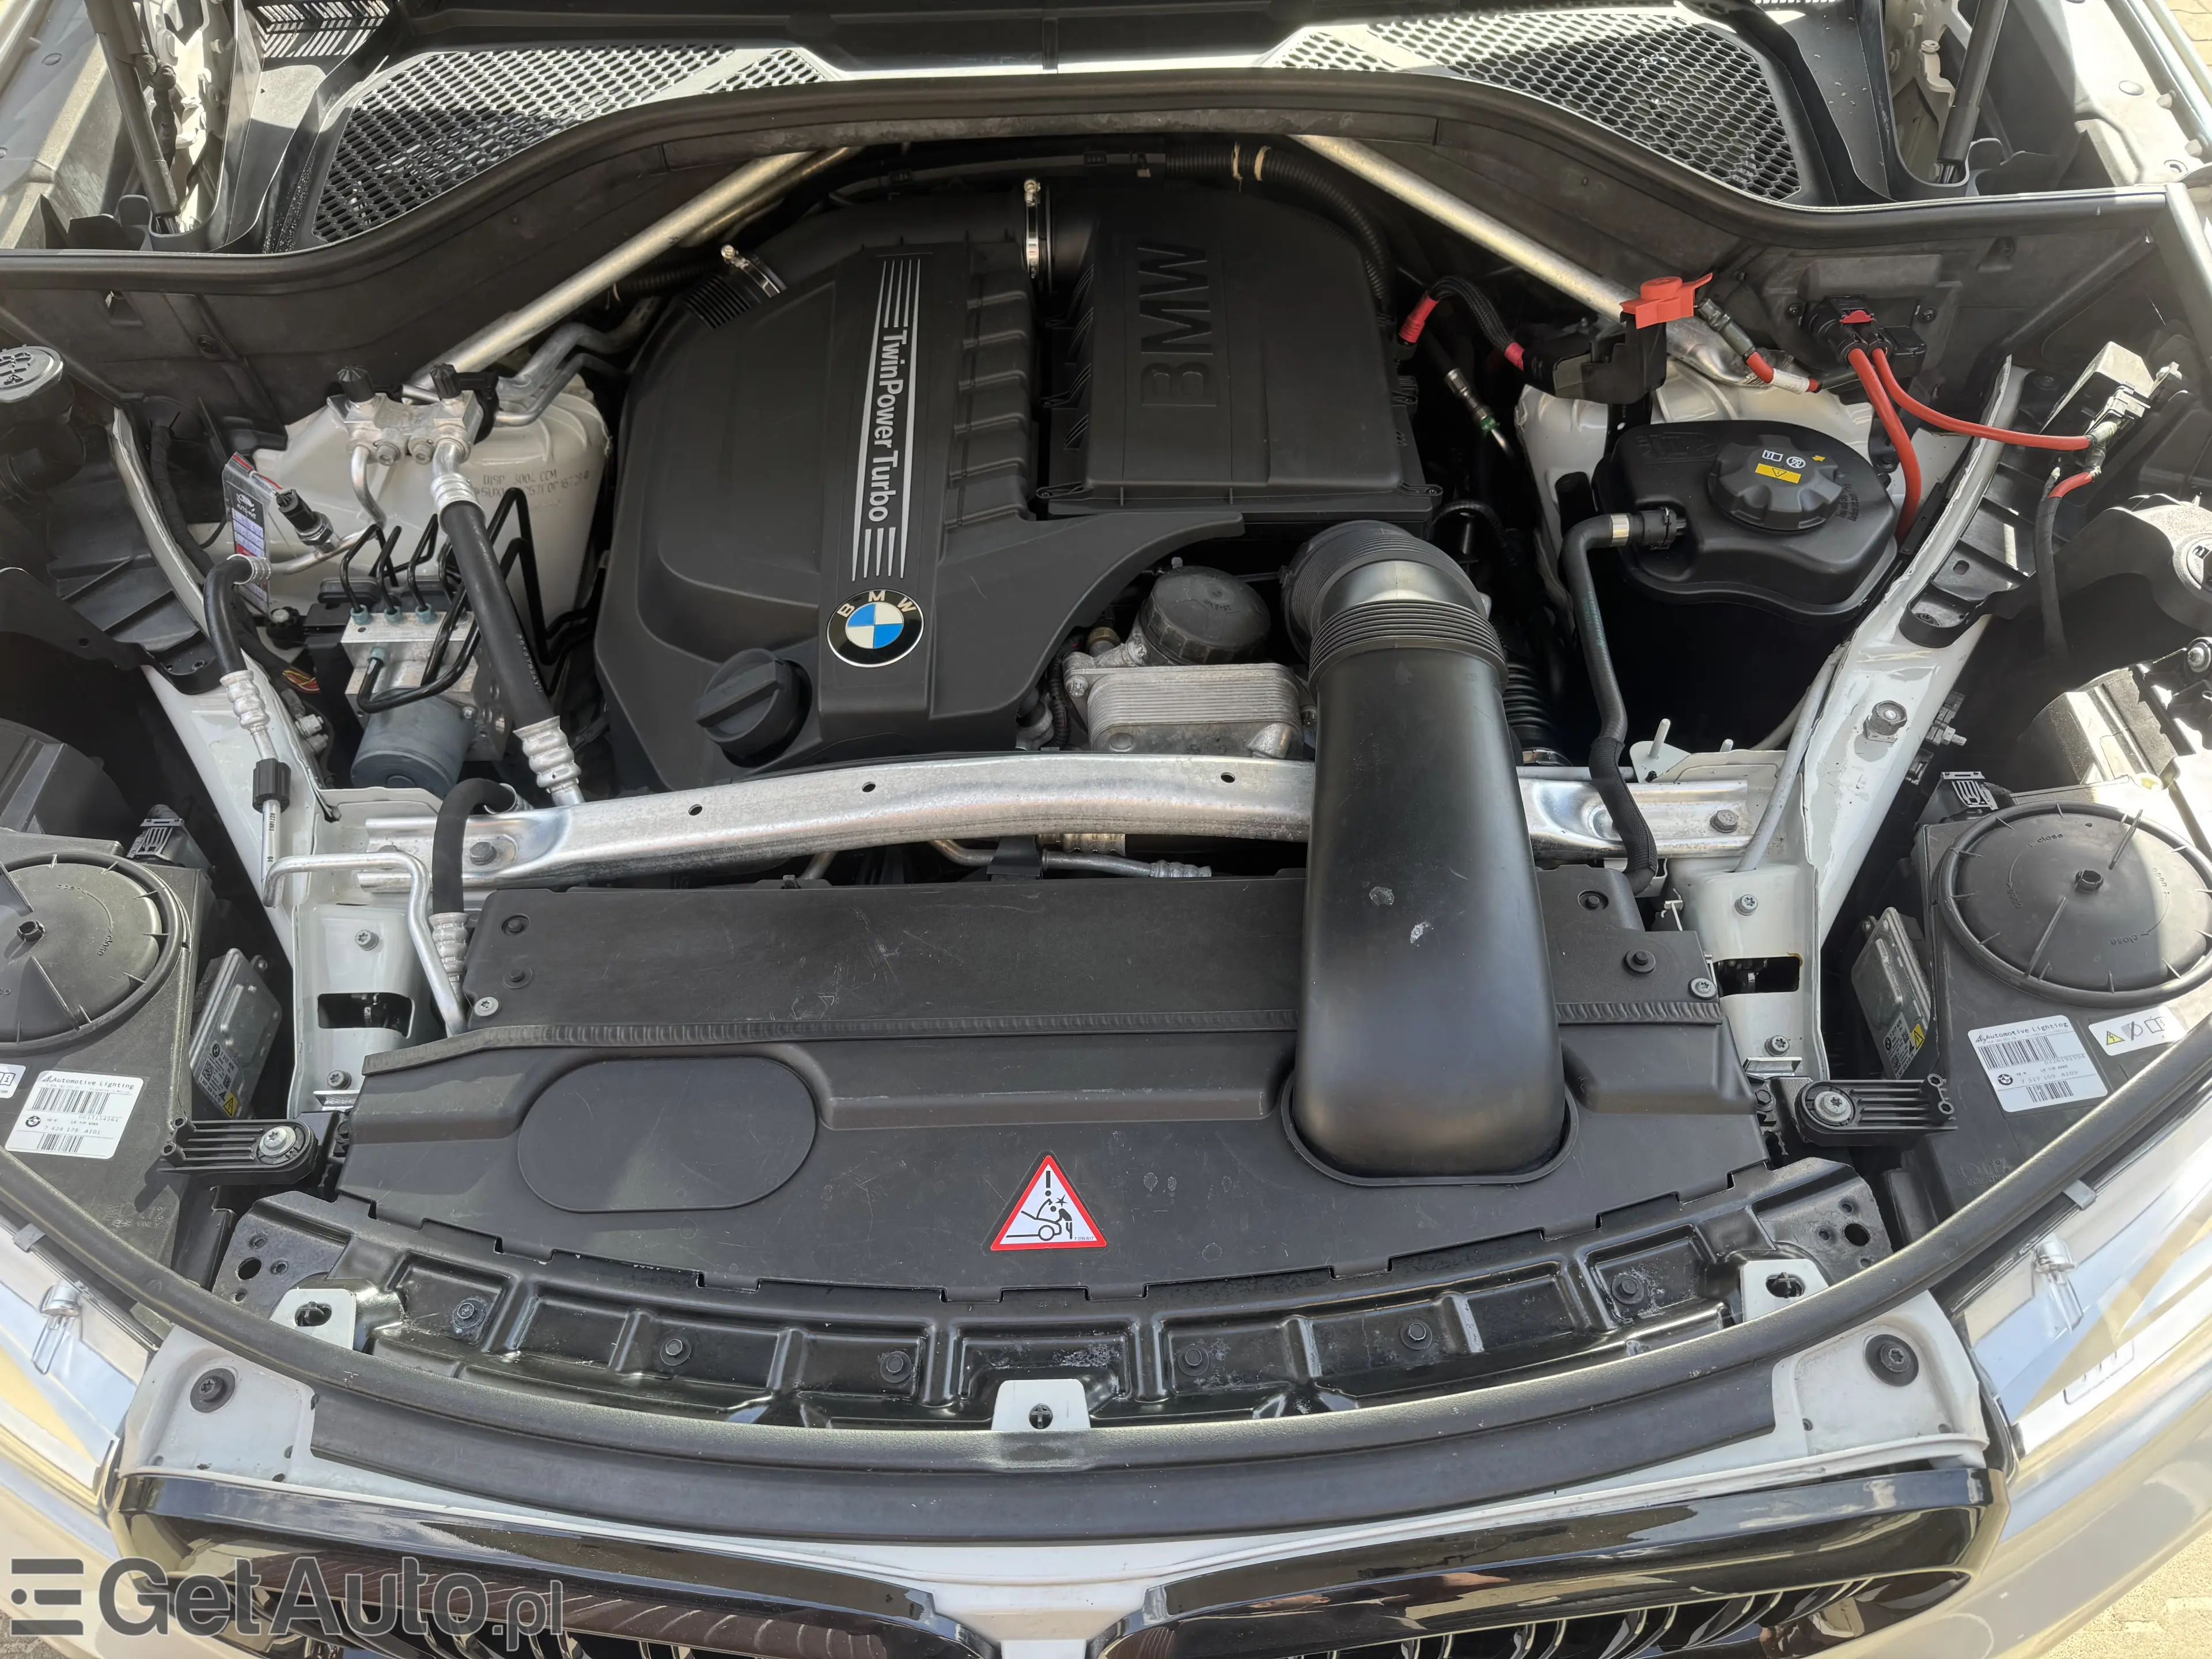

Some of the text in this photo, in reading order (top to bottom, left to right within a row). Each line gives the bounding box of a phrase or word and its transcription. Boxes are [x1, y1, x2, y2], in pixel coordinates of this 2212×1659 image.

[1137, 241, 1216, 407] BMW
[869, 329, 907, 522] TwinPower Turbo
[836, 590, 917, 618] BMW
[2037, 833, 2063, 844] close
[97, 934, 113, 957] close
[1985, 1028, 2029, 1040] Automotive
[2032, 1021, 2069, 1033] Lighting
[52, 1077, 135, 1090] Automotive Lighting
